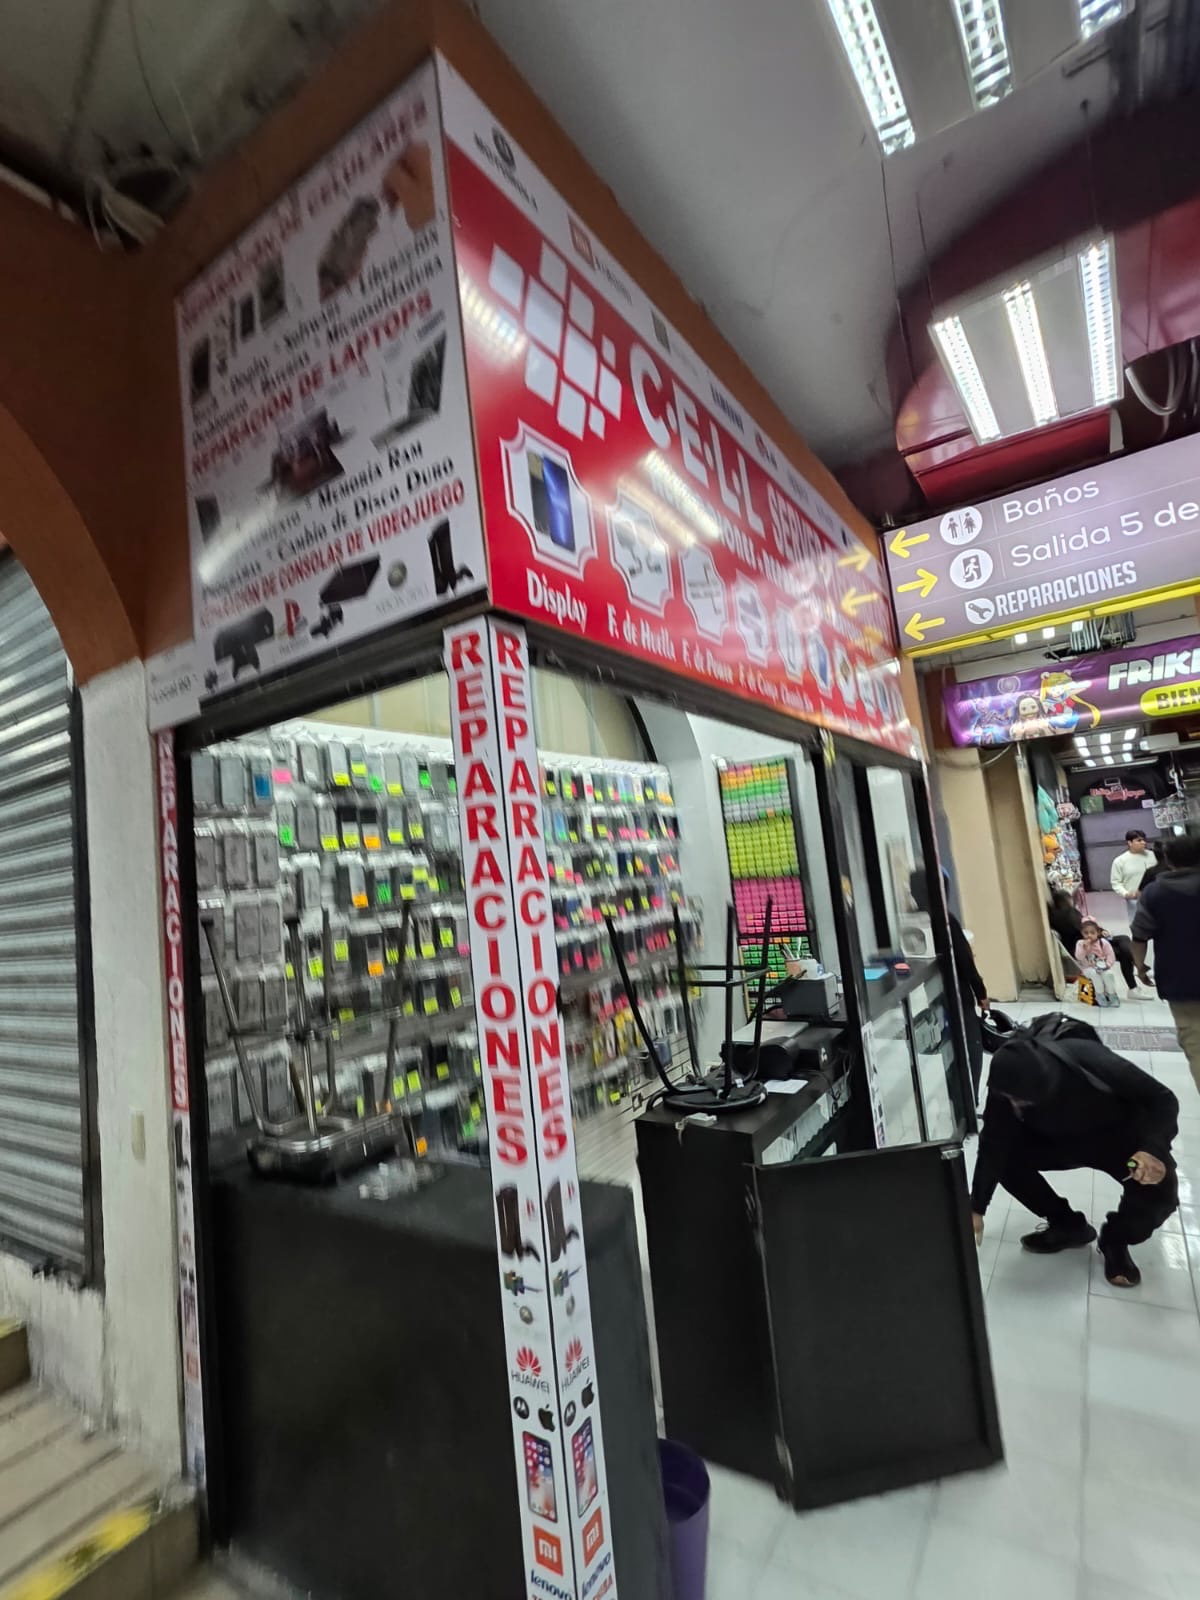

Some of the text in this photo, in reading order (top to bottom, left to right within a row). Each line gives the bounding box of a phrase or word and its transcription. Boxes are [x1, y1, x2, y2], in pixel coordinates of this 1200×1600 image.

[279, 539, 343, 589] CONSOLAS
[366, 478, 466, 546] VIDEOJUEGO
[1002, 479, 1099, 524] Baños
[1011, 501, 1200, 567] Salida 5 de
[526, 568, 588, 632] Display
[994, 560, 1137, 617] REPARACIONES
[450, 629, 529, 1168] REPARACIONES
[494, 628, 569, 1161] REPARACIONES
[510, 1369, 551, 1394] HUAWEI
[561, 1355, 591, 1394] HUAWEI
